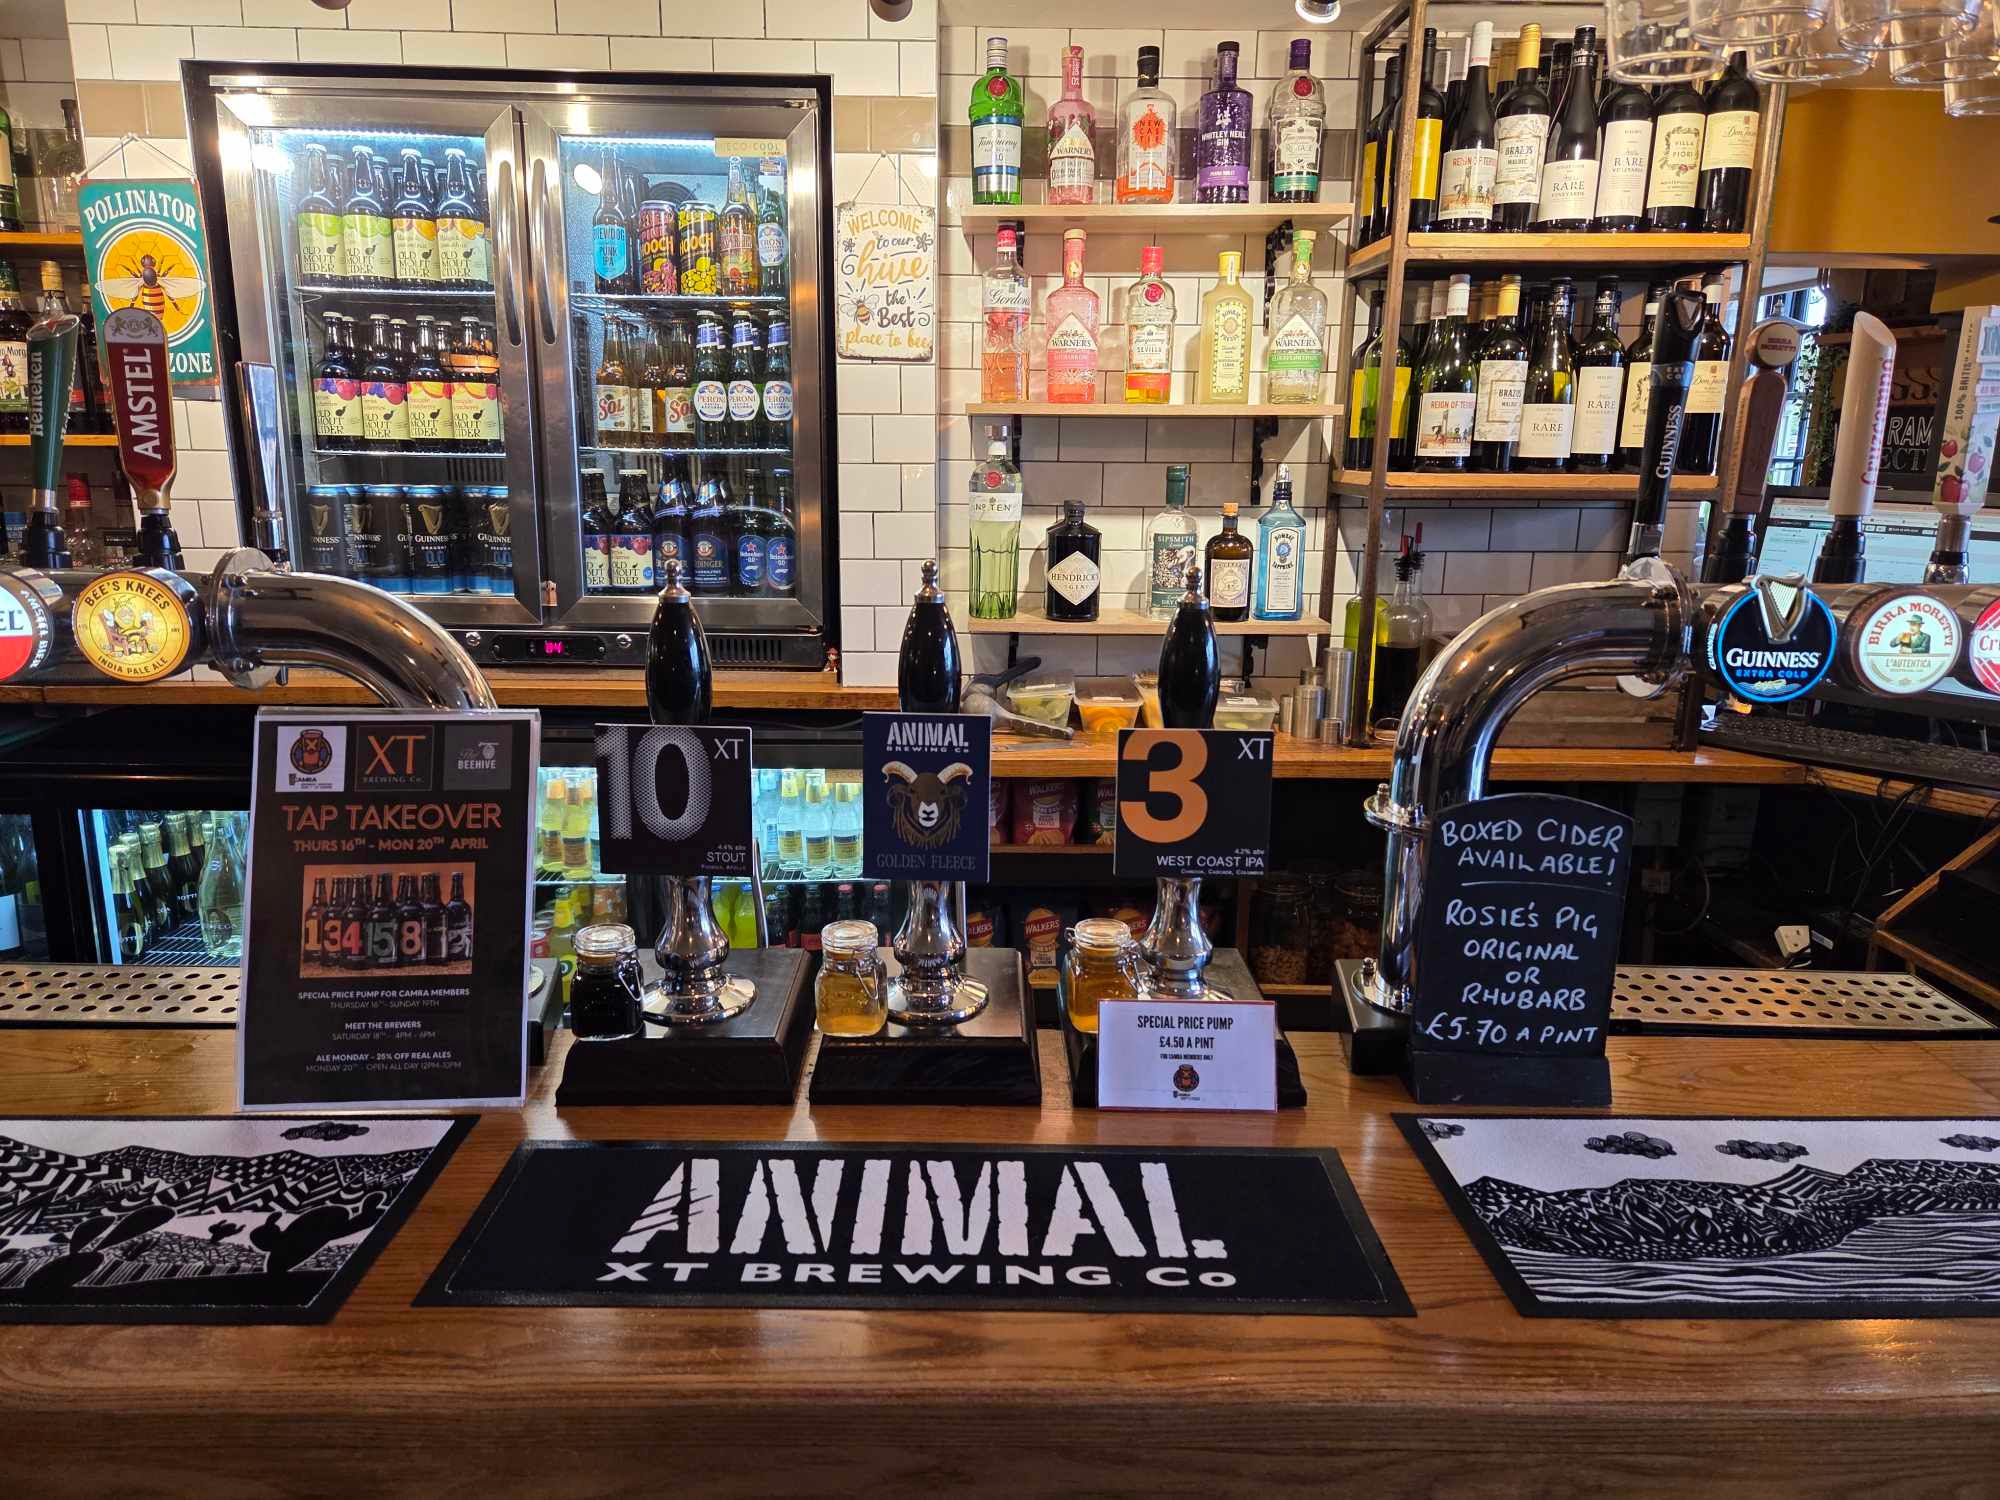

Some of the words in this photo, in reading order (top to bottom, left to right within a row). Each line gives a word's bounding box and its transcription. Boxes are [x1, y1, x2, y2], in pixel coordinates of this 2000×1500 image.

[1202, 131, 1228, 141] WHITLEY
[1229, 131, 1246, 139] NEILL
[1217, 138, 1229, 146] GIN
[1614, 157, 1644, 167] RARE
[1552, 181, 1585, 191] RARE
[84, 190, 197, 234] POLLINATOR
[847, 209, 922, 237] WELCOME
[680, 233, 714, 254] HOOCH
[877, 234, 890, 250] to
[891, 236, 914, 247] our
[856, 239, 928, 286] hive
[886, 289, 906, 306] the
[877, 306, 918, 328] Best
[845, 325, 883, 351] place
[30, 351, 44, 438] Heineken
[123, 348, 162, 461] AMSTEL
[1532, 423, 1564, 432] RARE
[1656, 404, 1682, 478] GUINNESS
[1157, 535, 1194, 543] SIPSMITH
[85, 580, 121, 607] BEE'S
[125, 580, 170, 610] KNEES
[1869, 605, 1907, 645] BIRRA
[1909, 602, 1953, 647] MORETTI
[1706, 622, 1718, 671] GUINNESS
[98, 656, 123, 673] INDIA
[127, 666, 149, 674] PALE
[152, 656, 168, 671] ALE
[1726, 648, 1821, 669] GUINNESS
[1736, 669, 1773, 678] EXTRA
[1777, 670, 1809, 678] COLD
[886, 721, 969, 747] ANIMAL
[366, 735, 426, 776] XT
[714, 738, 744, 760] XT
[1238, 738, 1271, 760] XT
[457, 759, 496, 770] BEEHIVE
[593, 725, 712, 841] 10
[1120, 730, 1208, 843] 3
[281, 804, 338, 832] TAP
[346, 803, 503, 832] TAKEOVER
[293, 839, 337, 852] THURS
[378, 838, 415, 850] MON
[450, 837, 489, 849] APRIL
[1442, 819, 1523, 847] BOXED
[1537, 818, 1624, 852] CIDER
[707, 851, 746, 863] STOUT
[876, 853, 926, 869] GOLDEN
[930, 855, 976, 870] FLEECE
[1156, 855, 1193, 867] WEST
[1197, 856, 1242, 868] COAST
[1245, 857, 1265, 868] IPA
[1024, 920, 1060, 934] WALKERS
[1556, 906, 1598, 939] PIG
[323, 920, 342, 951] 3
[341, 921, 363, 954] 4
[366, 922, 399, 957] 15
[401, 920, 423, 955] 8
[1463, 939, 1580, 962] ORIGINAL
[1505, 966, 1541, 985] OR
[298, 992, 330, 1000] SPECIAL
[331, 991, 355, 999] PRICE
[356, 990, 380, 998] PUMP
[398, 989, 429, 997] CAMRA
[430, 988, 470, 996] MEMBERS
[1461, 982, 1587, 1011] RHUBARB
[330, 1001, 369, 1009] THURSDAY
[345, 1022, 367, 1030] MEET
[384, 1021, 422, 1029] BREWERS
[1137, 1015, 1176, 1029] SPECIAL
[1177, 1016, 1205, 1030] PRICE
[1207, 1017, 1234, 1030] PUMP
[1425, 1011, 1508, 1046] £5.70
[1515, 1026, 1531, 1043] A
[1539, 1026, 1599, 1045] PINT
[332, 1033, 371, 1041] SATURDAY
[1159, 1036, 1185, 1048] £4.50
[1186, 1037, 1193, 1048] A
[1195, 1037, 1215, 1049] PINT
[332, 1054, 369, 1062] MONDAY
[394, 1052, 411, 1060] OFF
[411, 1052, 431, 1060] REAL
[432, 1051, 452, 1059] ALES
[306, 1065, 341, 1073] MONDAY
[610, 1158, 1229, 1260] ANIMAL
[596, 1262, 709, 1283] XT
[741, 1263, 1112, 1286] BREWING
[1145, 1266, 1237, 1288] Co
